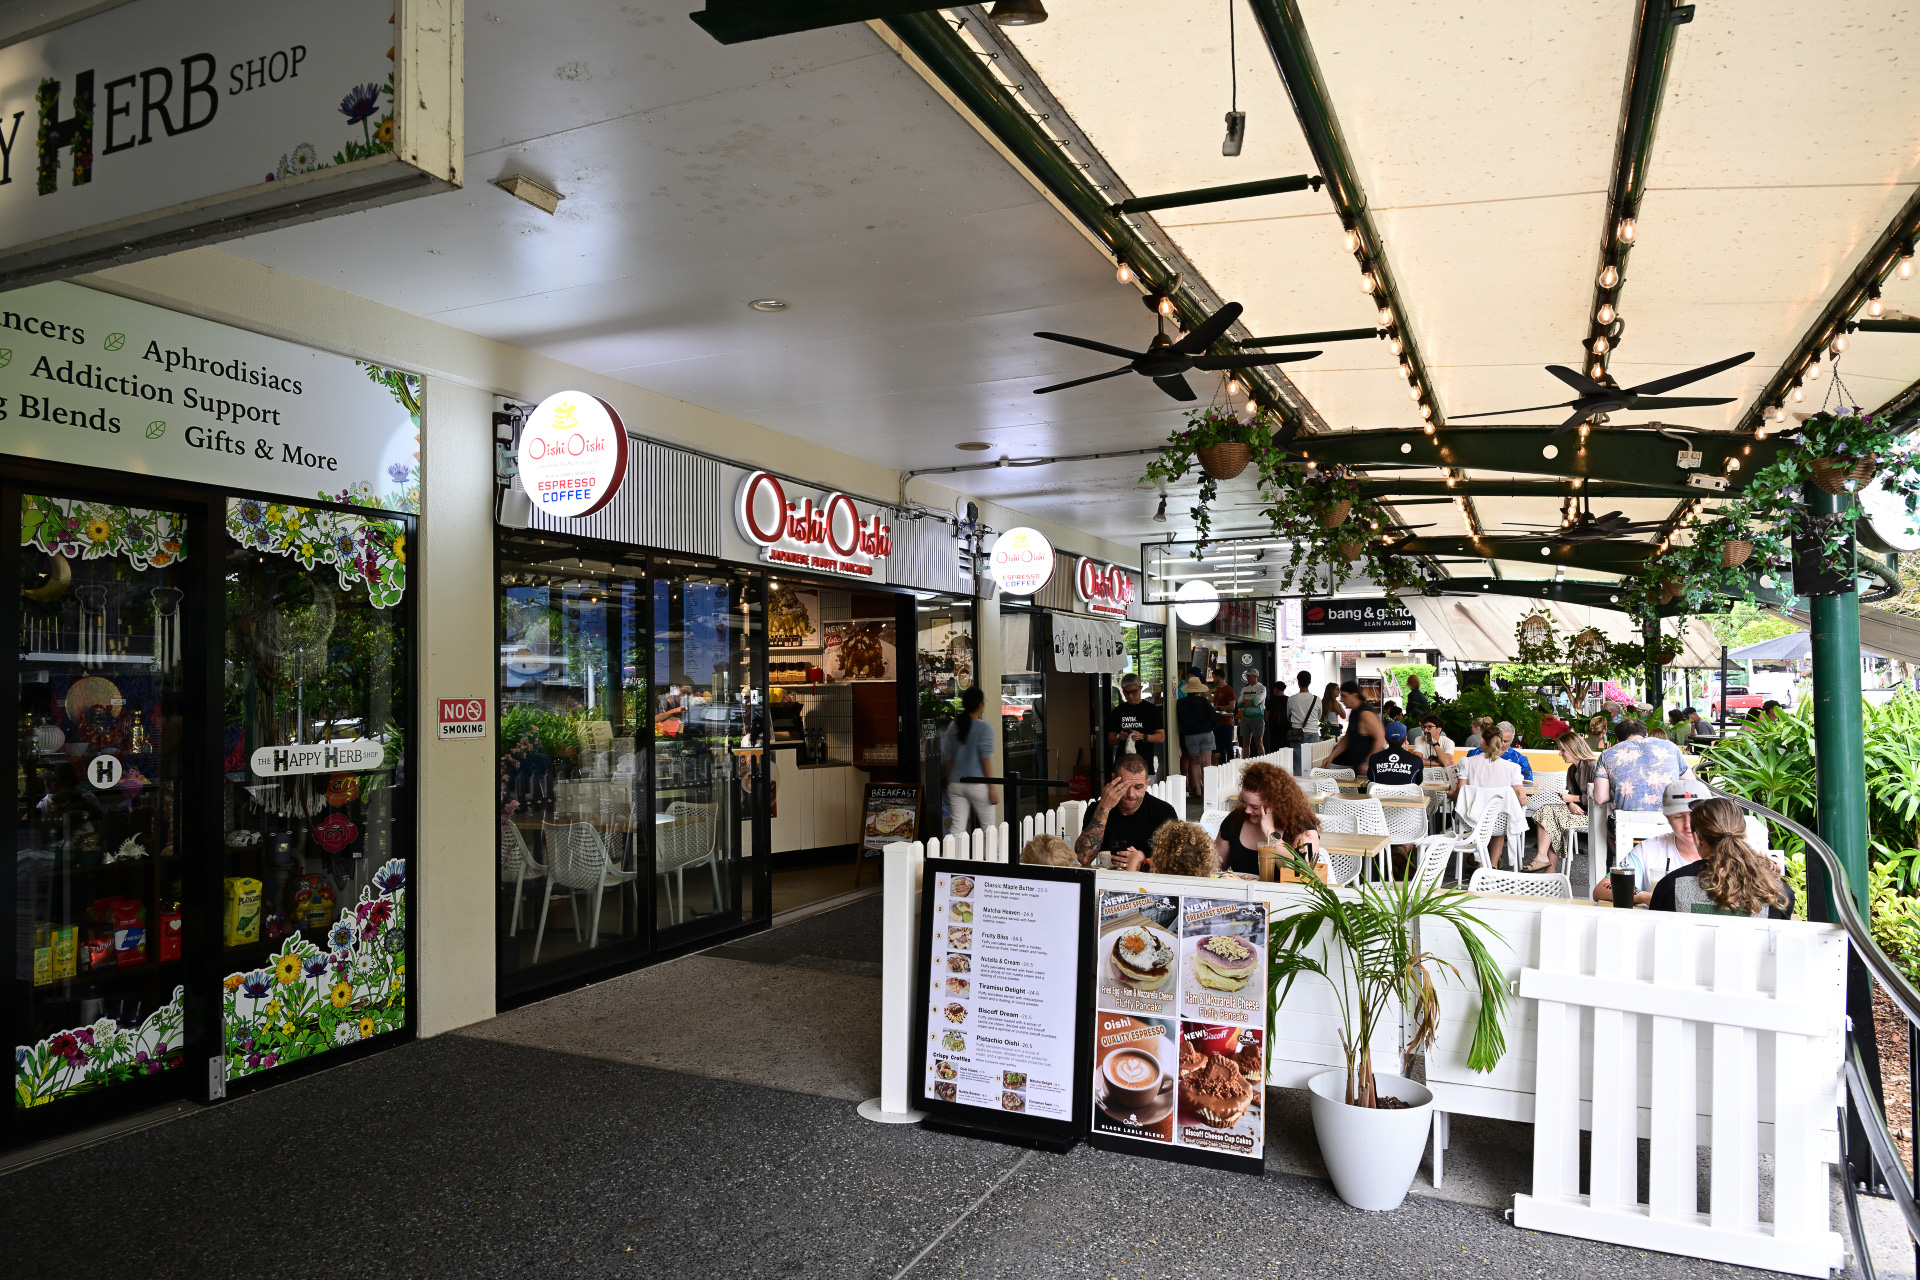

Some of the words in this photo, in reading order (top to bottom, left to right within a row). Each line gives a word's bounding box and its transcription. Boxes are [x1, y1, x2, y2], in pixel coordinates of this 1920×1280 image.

[36, 53, 219, 196] HERB
[229, 45, 306, 96] SHOP
[0, 311, 85, 345] ncers
[142, 340, 302, 396] Aphrodisiacs
[30, 356, 174, 405] Addiction
[183, 387, 281, 426] Support
[19, 394, 121, 433] Blends
[184, 426, 245, 455] Gifts
[254, 440, 274, 461] &
[281, 444, 338, 471] More
[529, 438, 565, 460] Oishi
[567, 434, 605, 456] Oishi
[538, 477, 596, 491] ESPRESSO
[542, 488, 592, 503] COFFEE
[744, 472, 827, 544] Oishi
[826, 493, 893, 558] Oishi
[769, 549, 810, 566] JAPANESE
[996, 551, 1020, 564] Oishi
[1021, 550, 1046, 563] Oishi
[1002, 573, 1040, 581] ESPRESSO
[1005, 579, 1037, 588] COFFEE
[1328, 608, 1361, 621] bang
[1363, 606, 1375, 619] &
[445, 703, 465, 720] NO
[443, 724, 483, 735] SMOKING
[258, 757, 271, 766] THE
[273, 749, 322, 772] HAPPY
[324, 746, 362, 768] HERB
[363, 752, 379, 760] SHOP
[1376, 762, 1412, 771] INSTANT
[96, 760, 113, 784] H
[871, 788, 917, 798] BREAKFAST
[1104, 894, 1129, 906] NEW!
[1104, 902, 1133, 915] BREAKFAST
[1132, 898, 1154, 908] SPECIAL
[1185, 901, 1213, 913] NEW!
[983, 906, 1001, 914] Matcha
[1186, 908, 1216, 922] BREAKFAST
[1216, 904, 1239, 915] SPECIAL
[981, 932, 995, 940] Fruity
[979, 983, 1003, 992] Tiramisu
[1005, 986, 1026, 995] Delight
[1111, 987, 1121, 998] Egg
[1123, 988, 1133, 998] Ham
[1159, 991, 1174, 1002] Cheese
[1115, 998, 1134, 1011] Fluffy
[1135, 1001, 1162, 1013] Pancake
[1185, 992, 1199, 1005] Ham
[1199, 994, 1205, 1006] &
[1205, 994, 1236, 1010] Mozzarella
[1236, 996, 1260, 1012] Cheese
[979, 1007, 999, 1016] Biscoff
[999, 1010, 1019, 1018] Dream
[1199, 1007, 1219, 1021] Fluffy
[1219, 1010, 1248, 1023] Pancake
[1104, 1017, 1132, 1031] Oishi
[976, 1035, 1003, 1045] Pistachio
[1004, 1039, 1020, 1047] Oishi
[1102, 1033, 1131, 1046] QUALITY
[1131, 1025, 1165, 1040] ESPRESSO
[1183, 1030, 1206, 1041] NEW!
[933, 1052, 949, 1061] Crispy
[1101, 1124, 1122, 1132] BLACK
[1185, 1127, 1204, 1139] Biscoff
[1204, 1131, 1224, 1143] Cheese
[1224, 1134, 1235, 1146] Cup
[1235, 1136, 1253, 1147] Cakes
